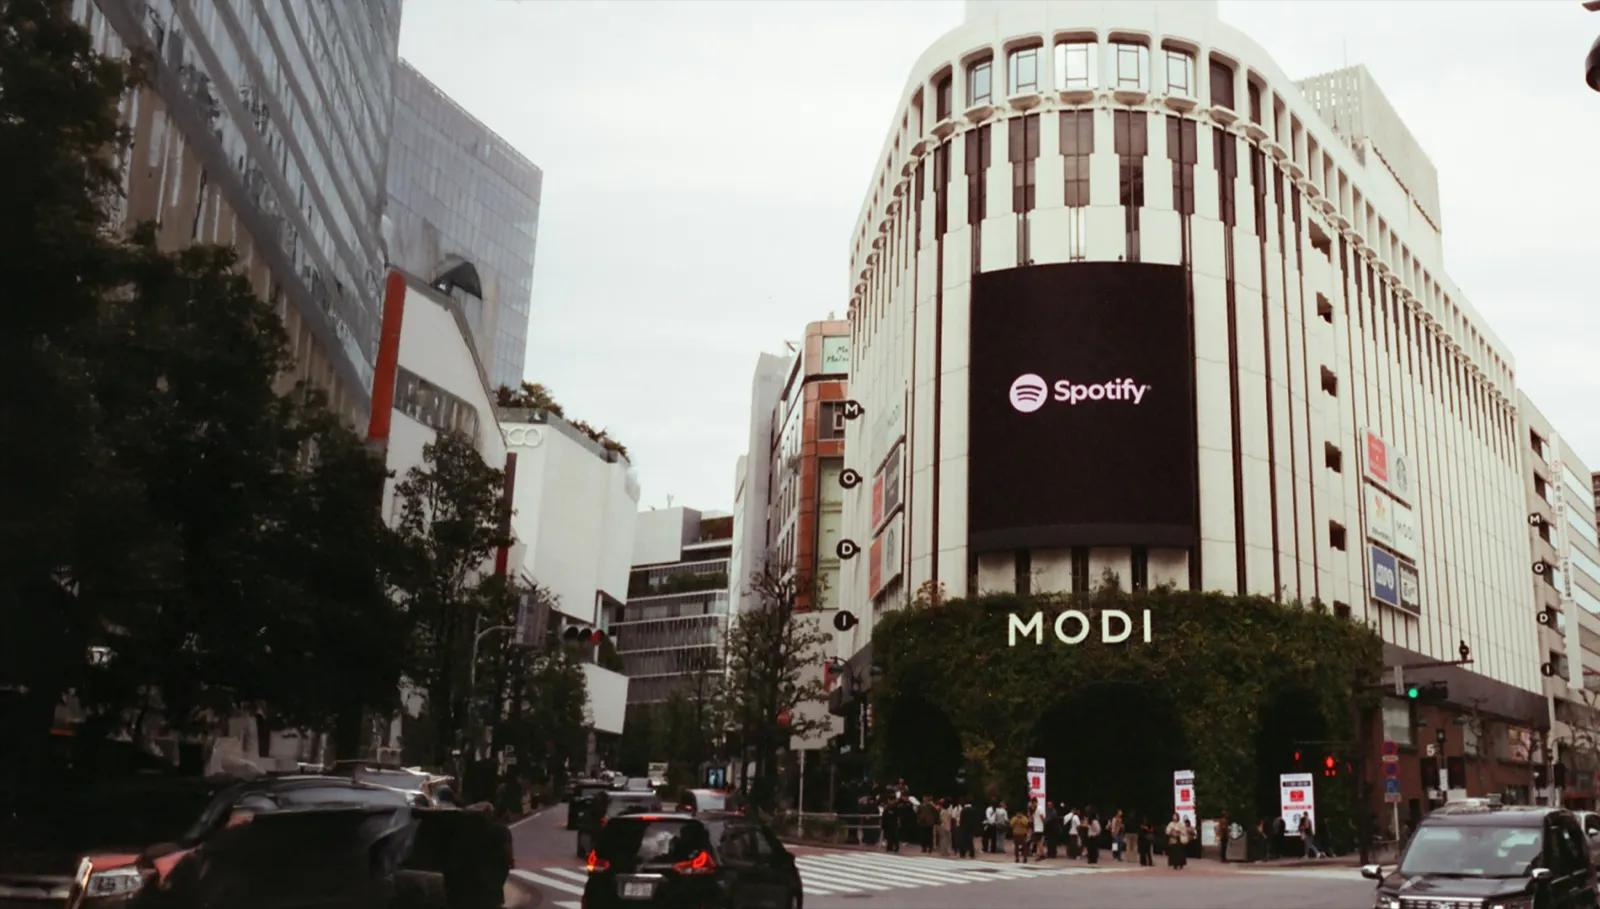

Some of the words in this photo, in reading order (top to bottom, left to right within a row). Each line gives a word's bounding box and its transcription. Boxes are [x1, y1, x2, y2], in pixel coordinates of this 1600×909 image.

[1054, 378, 1147, 405] Spotify
[503, 426, 542, 447] CO
[1008, 609, 1152, 647] MODI
